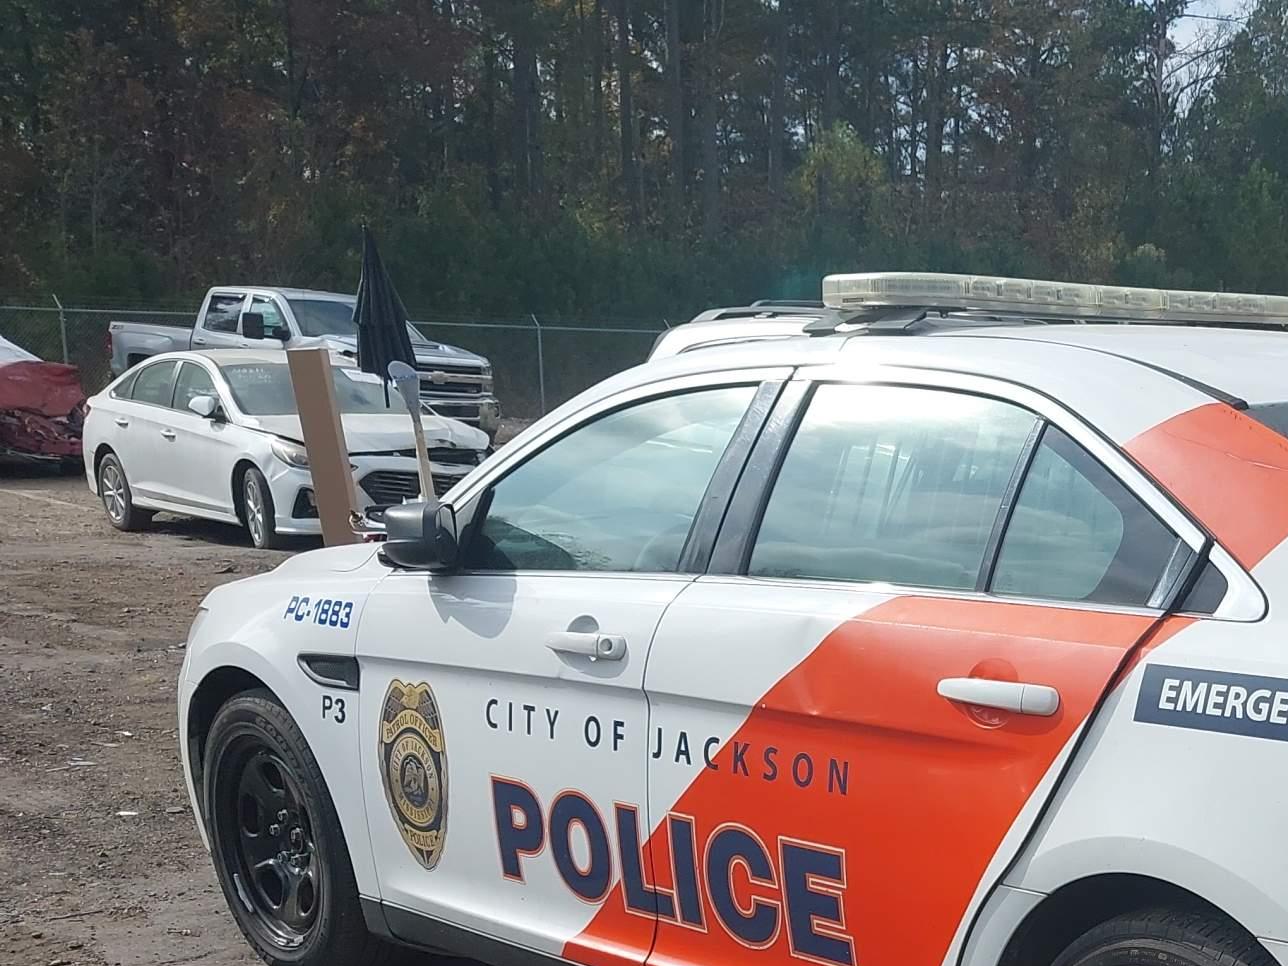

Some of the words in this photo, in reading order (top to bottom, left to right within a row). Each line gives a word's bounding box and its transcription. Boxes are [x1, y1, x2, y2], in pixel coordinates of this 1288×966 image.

[284, 596, 354, 629] PC-1883
[322, 695, 346, 724] P3
[386, 713, 408, 739] PATROL
[410, 713, 438, 748] OFFICER
[486, 699, 560, 739] CITY
[584, 716, 625, 751] OF
[652, 727, 850, 796] JACKSON
